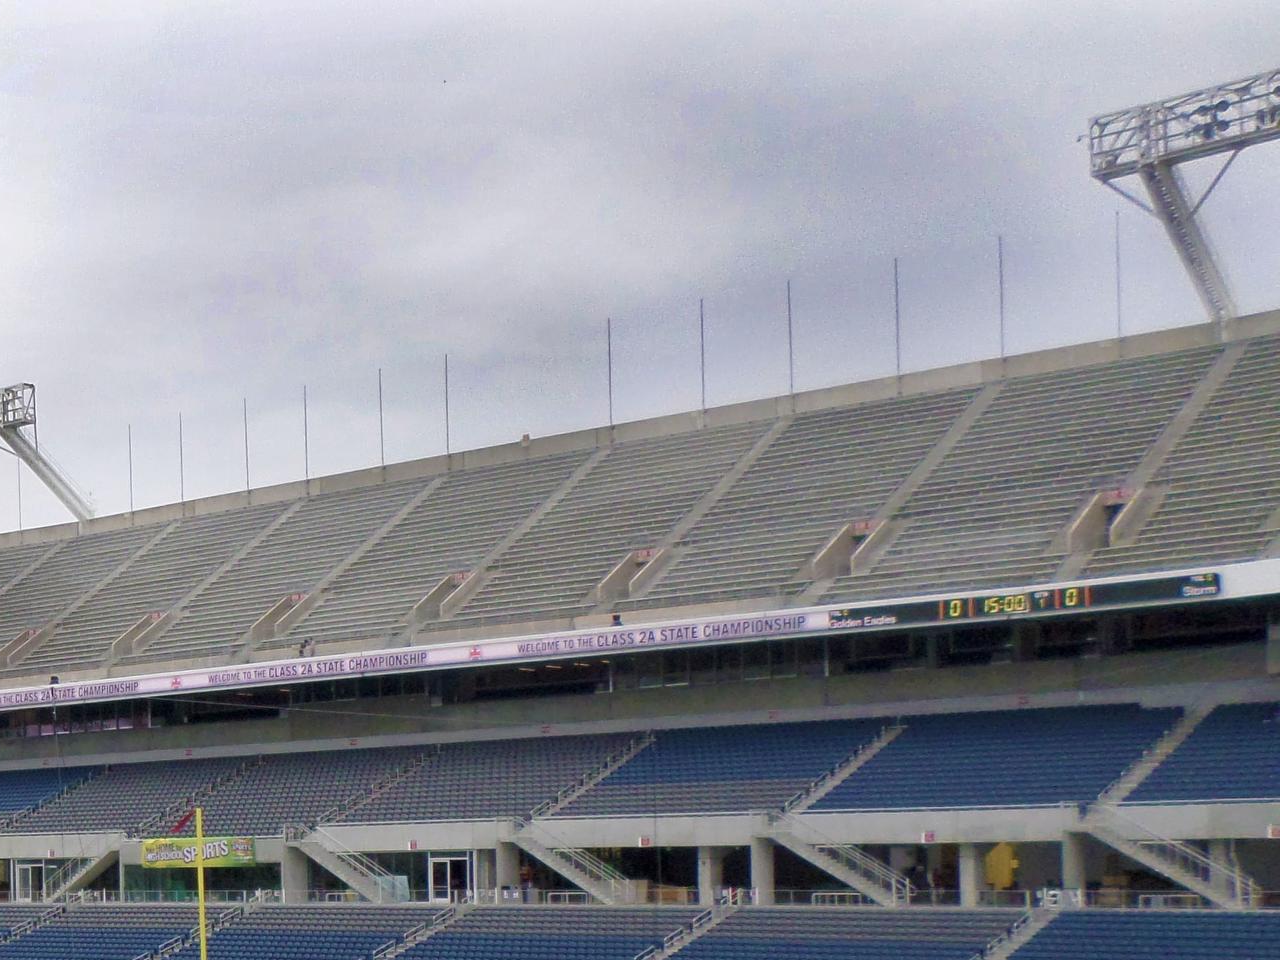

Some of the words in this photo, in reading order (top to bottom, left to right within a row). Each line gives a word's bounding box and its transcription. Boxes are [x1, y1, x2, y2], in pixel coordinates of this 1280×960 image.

[984, 595, 1025, 613] 15:00
[1065, 588, 1078, 605] 0
[949, 600, 961, 617] 0
[517, 641, 559, 653] WELCOME
[563, 639, 573, 649] TO
[578, 637, 593, 647] THE
[597, 632, 634, 647] CLASS
[639, 631, 655, 643] 2A
[660, 627, 698, 641] STATE
[703, 616, 806, 637] CHAMPIONSHIP
[208, 672, 240, 683] WELCOME
[243, 671, 251, 680] TO
[254, 670, 266, 678] THE
[269, 665, 297, 678] CLASS
[301, 664, 313, 675] 2A
[317, 660, 345, 673] STATE
[349, 652, 427, 670] CHAMPIONSHIP
[3, 695, 15, 704] THE
[15, 692, 39, 704] CLASS
[41, 691, 50, 701] 2A
[53, 688, 75, 700] STATE
[78, 682, 138, 697] CHAMPIONSHIP
